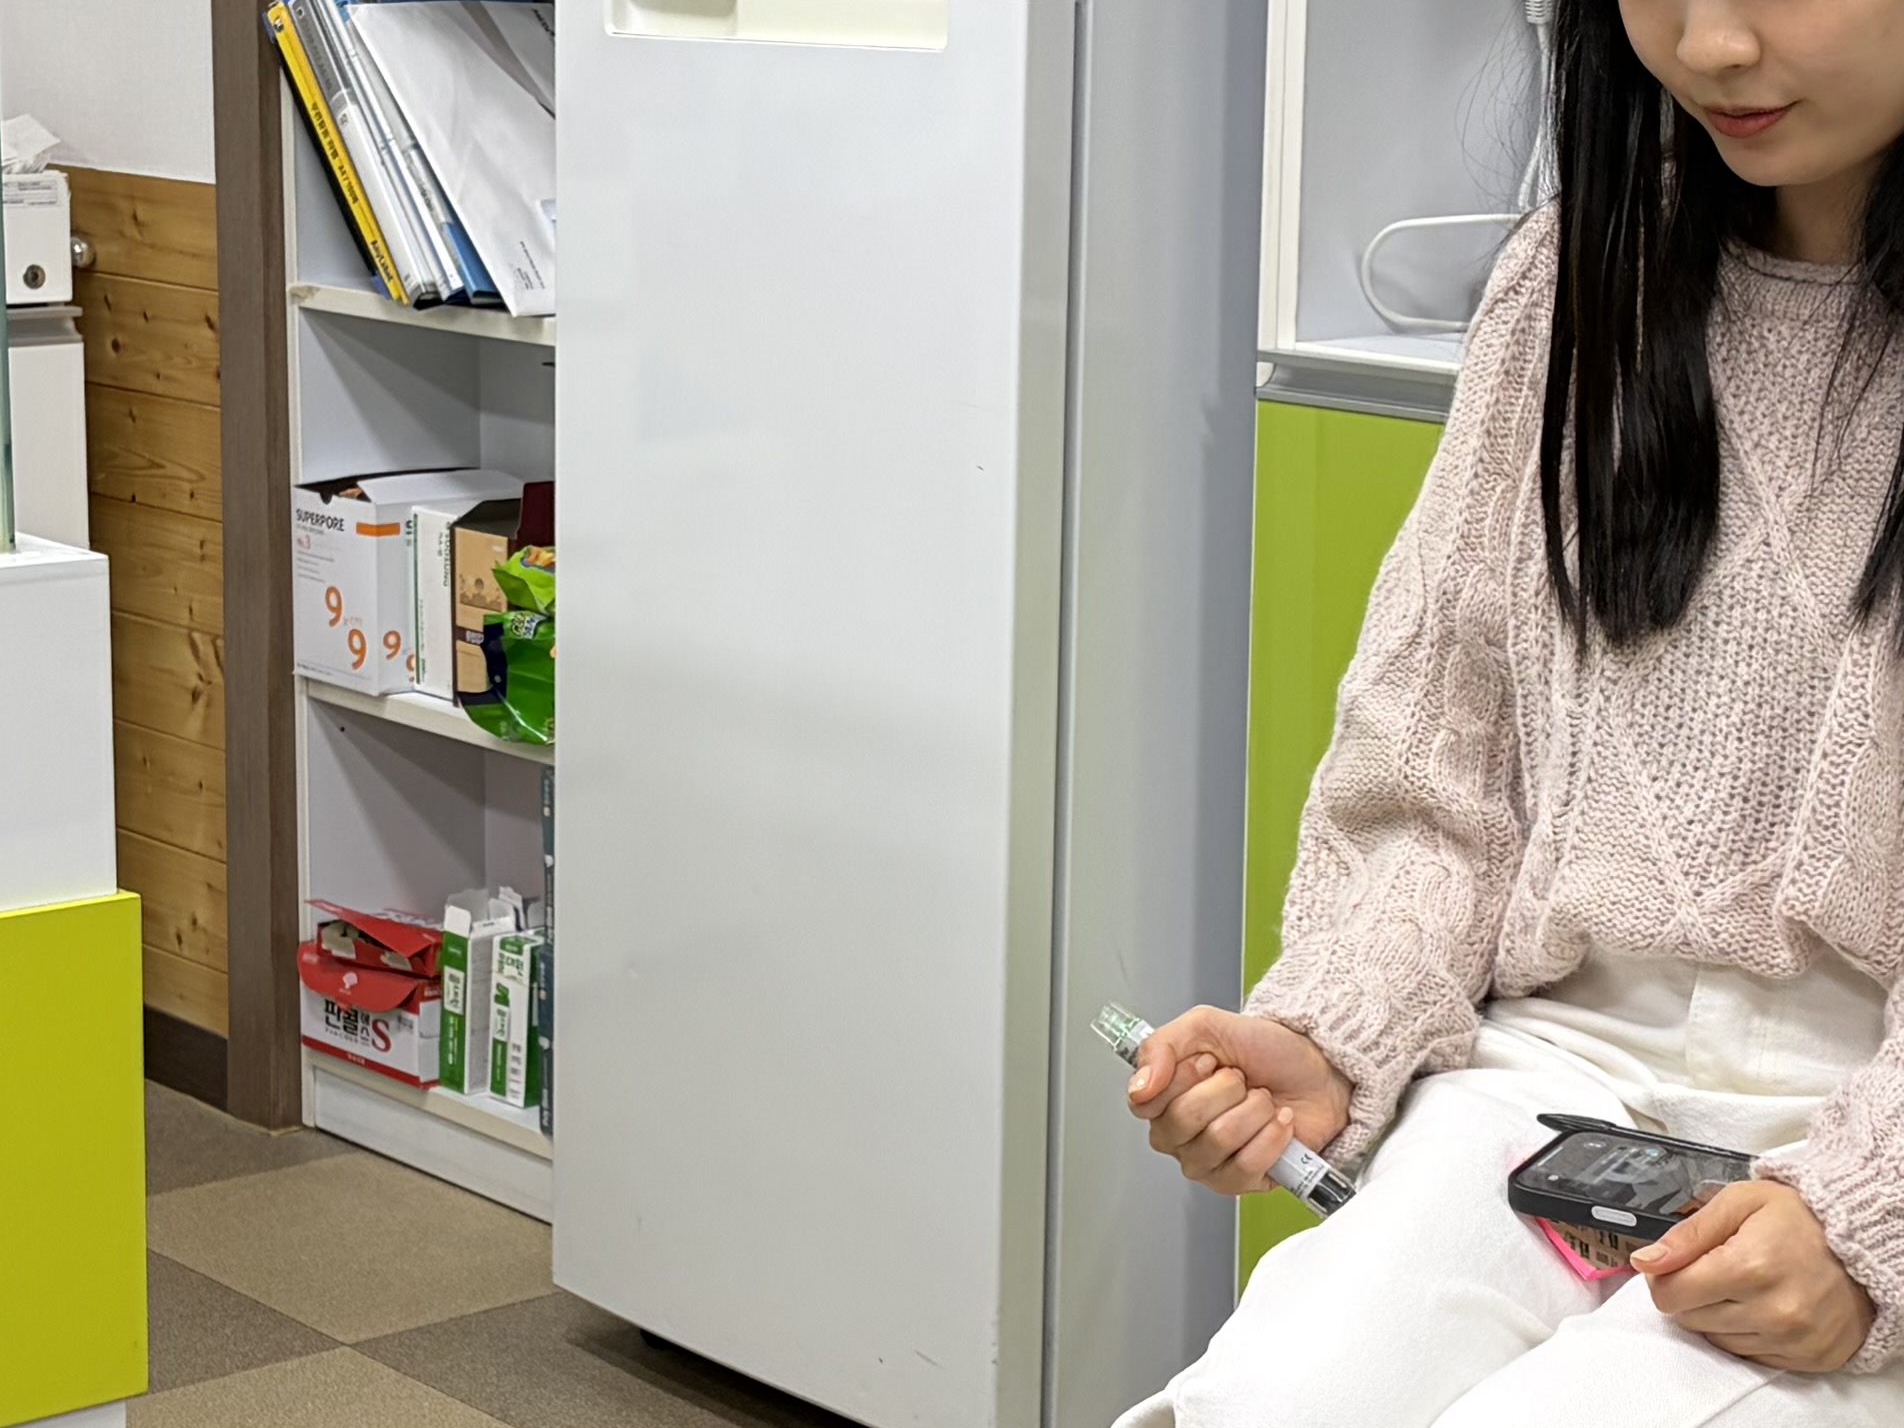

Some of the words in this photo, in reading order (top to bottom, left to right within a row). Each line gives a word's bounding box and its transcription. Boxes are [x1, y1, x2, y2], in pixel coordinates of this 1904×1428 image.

[324, 586, 342, 627] 9
[347, 628, 367, 670] 9
[383, 630, 401, 660] 9
